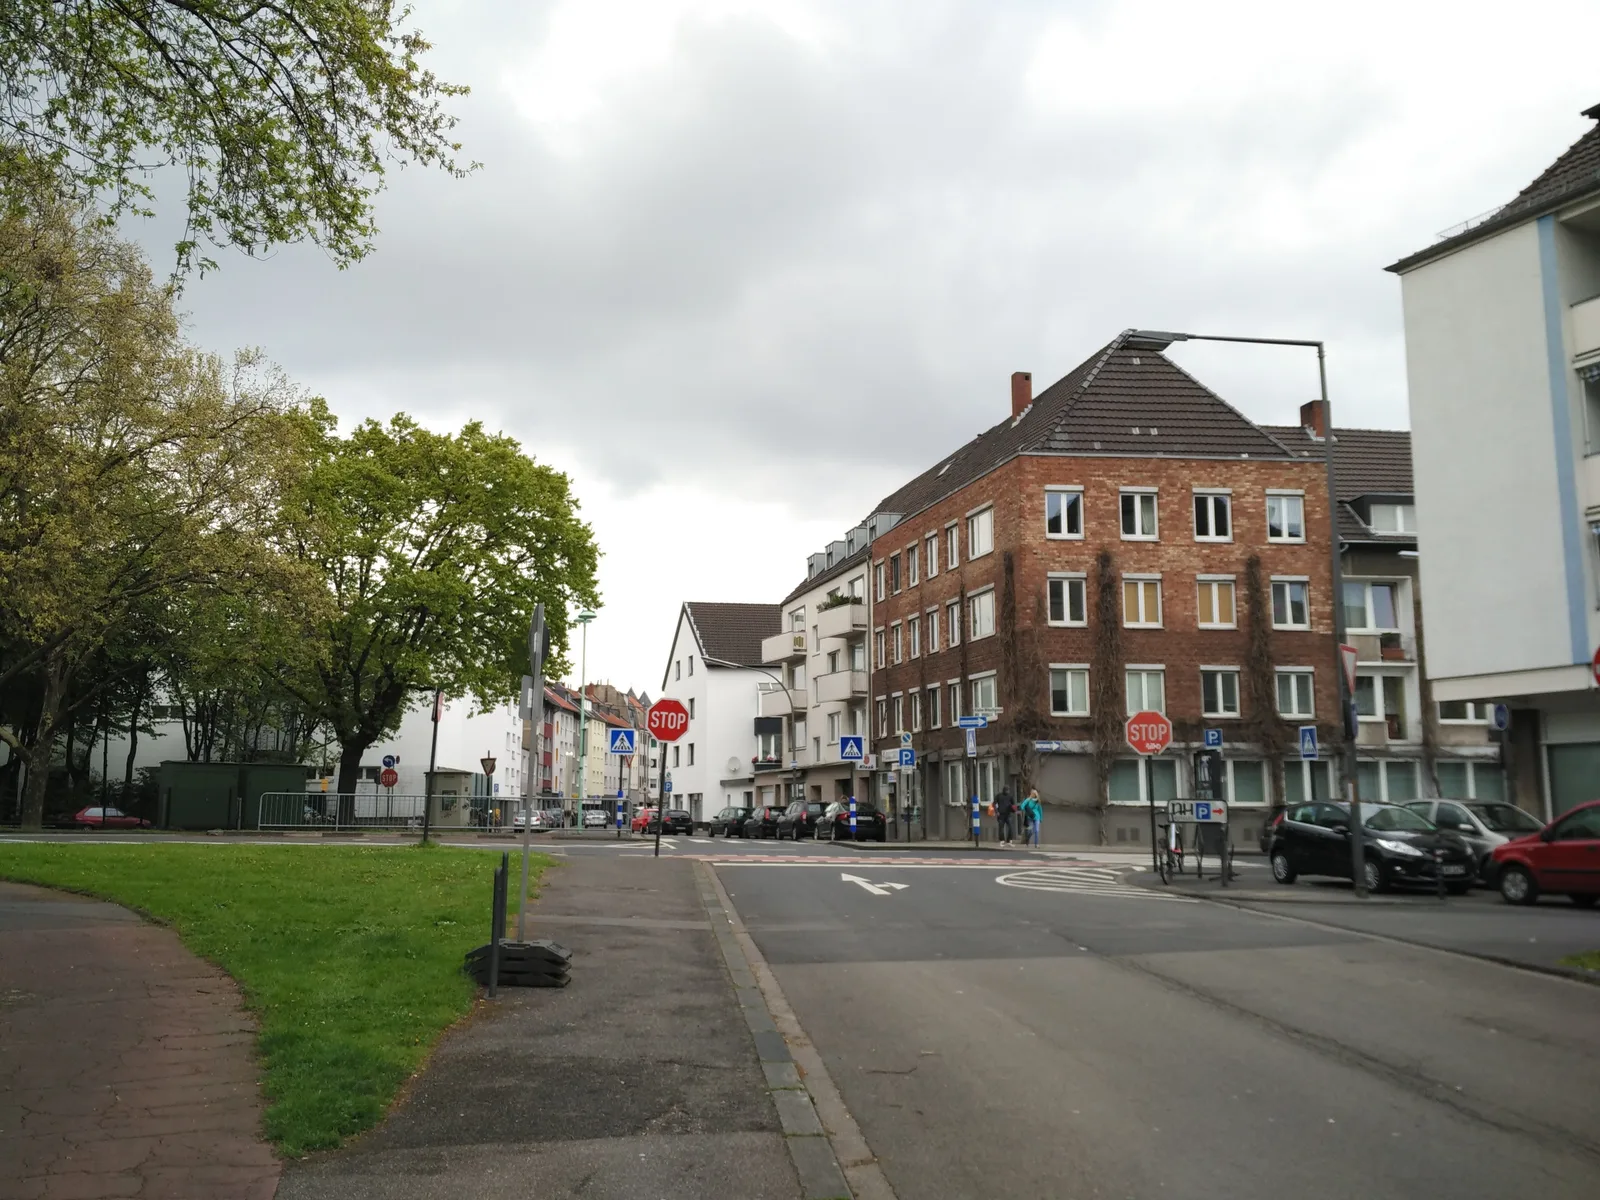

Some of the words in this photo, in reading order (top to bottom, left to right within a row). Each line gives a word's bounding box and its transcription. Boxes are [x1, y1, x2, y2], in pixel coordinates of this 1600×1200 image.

[650, 710, 687, 730] STOP
[1130, 724, 1167, 742] STOP
[1208, 731, 1218, 744] P
[902, 752, 911, 764] P
[382, 774, 397, 782] STOP
[1198, 808, 1208, 818] P
